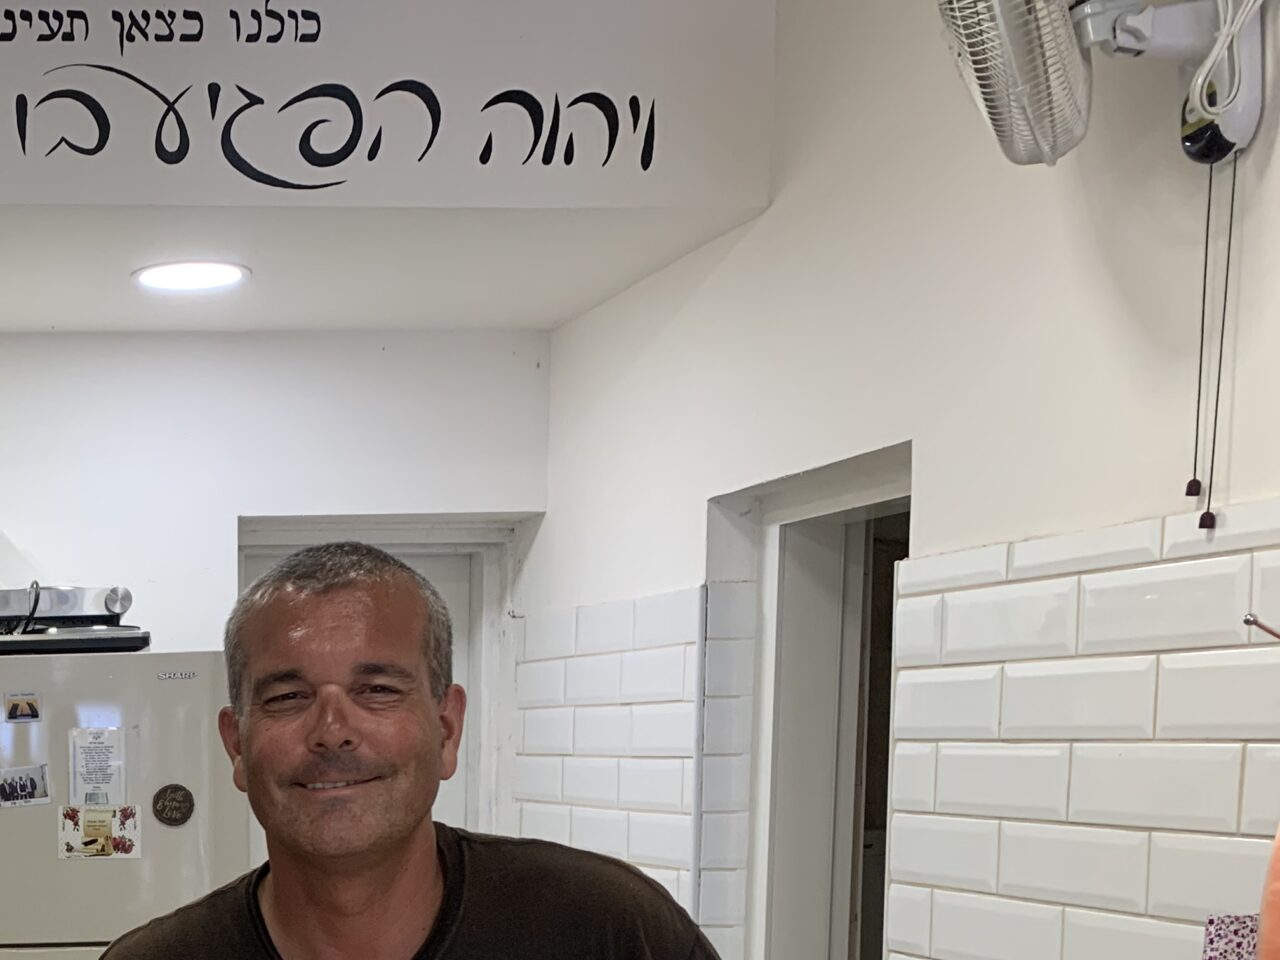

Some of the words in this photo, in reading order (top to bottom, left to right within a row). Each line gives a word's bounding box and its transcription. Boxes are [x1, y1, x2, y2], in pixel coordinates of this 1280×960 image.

[112, 9, 204, 56] כצאן
[230, 0, 322, 43] כולנו
[15, 88, 111, 158] בו
[42, 64, 442, 189] הפגיע
[479, 90, 656, 171] ויהוה
[158, 671, 198, 681] SHARP
